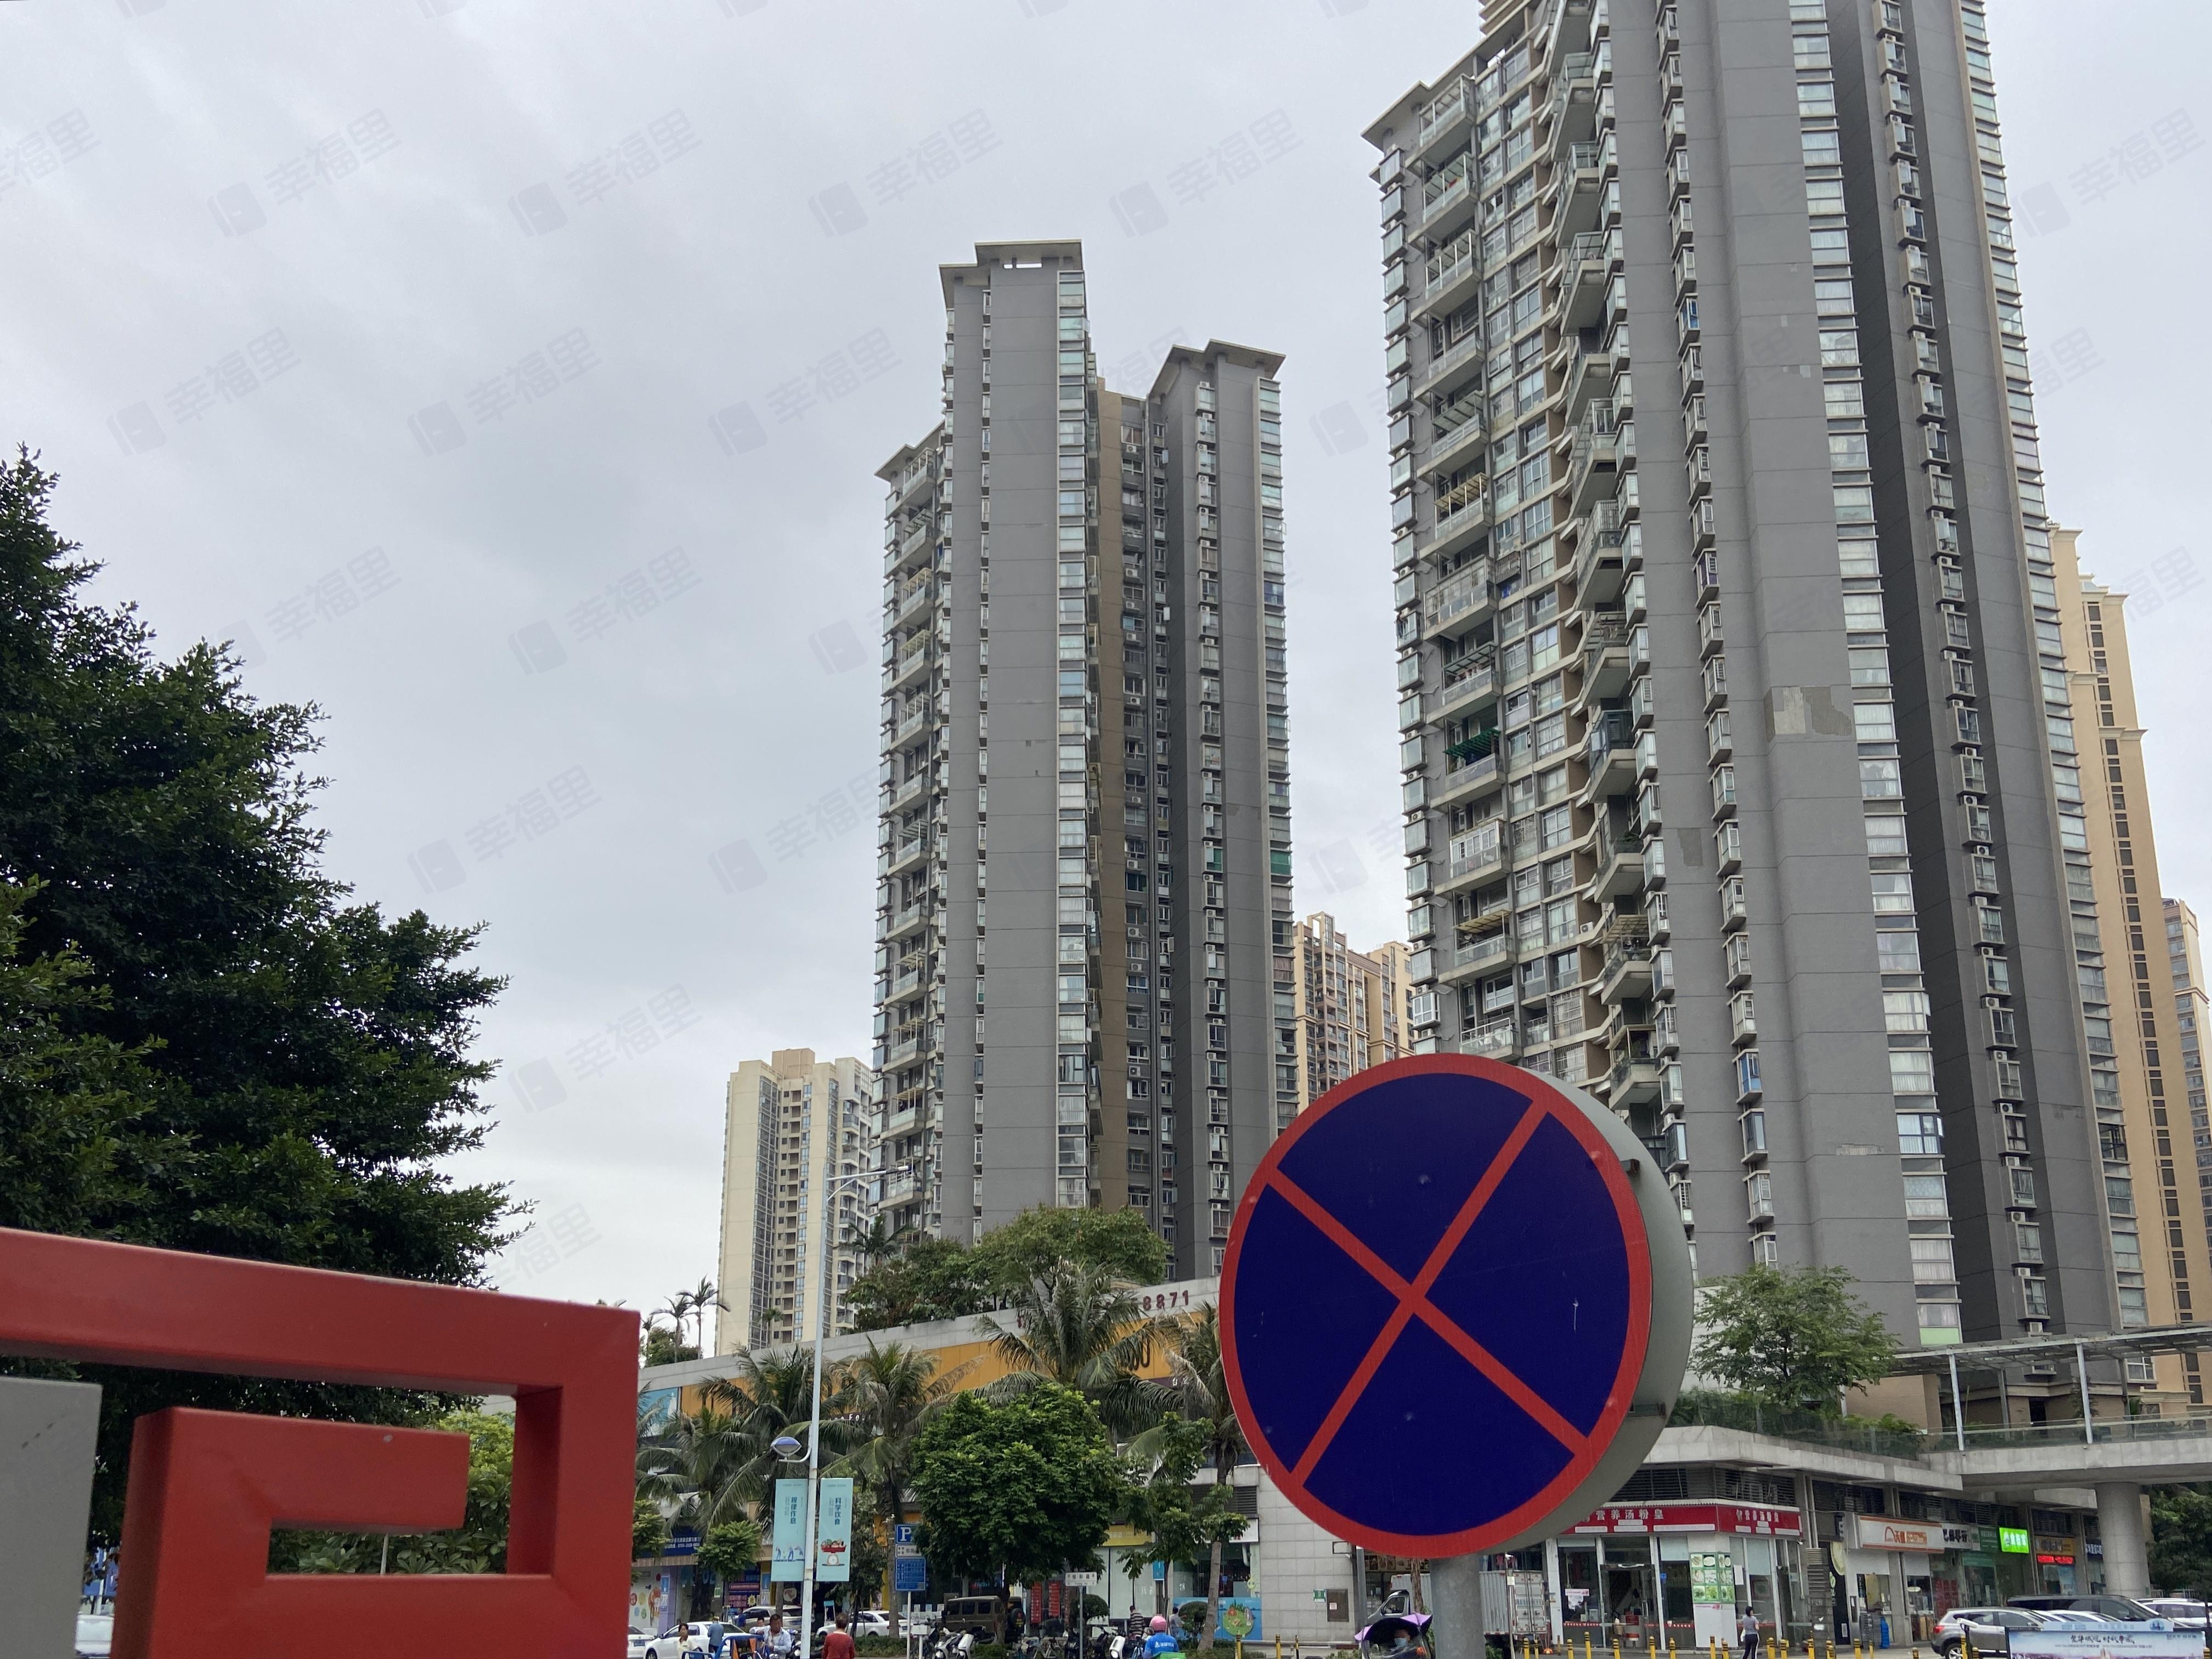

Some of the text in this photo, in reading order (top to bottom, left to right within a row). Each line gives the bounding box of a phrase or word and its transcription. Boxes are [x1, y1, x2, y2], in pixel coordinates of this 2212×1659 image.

[1582, 1509, 1664, 1522] 营养汤粉皇
[900, 1527, 911, 1541] P
